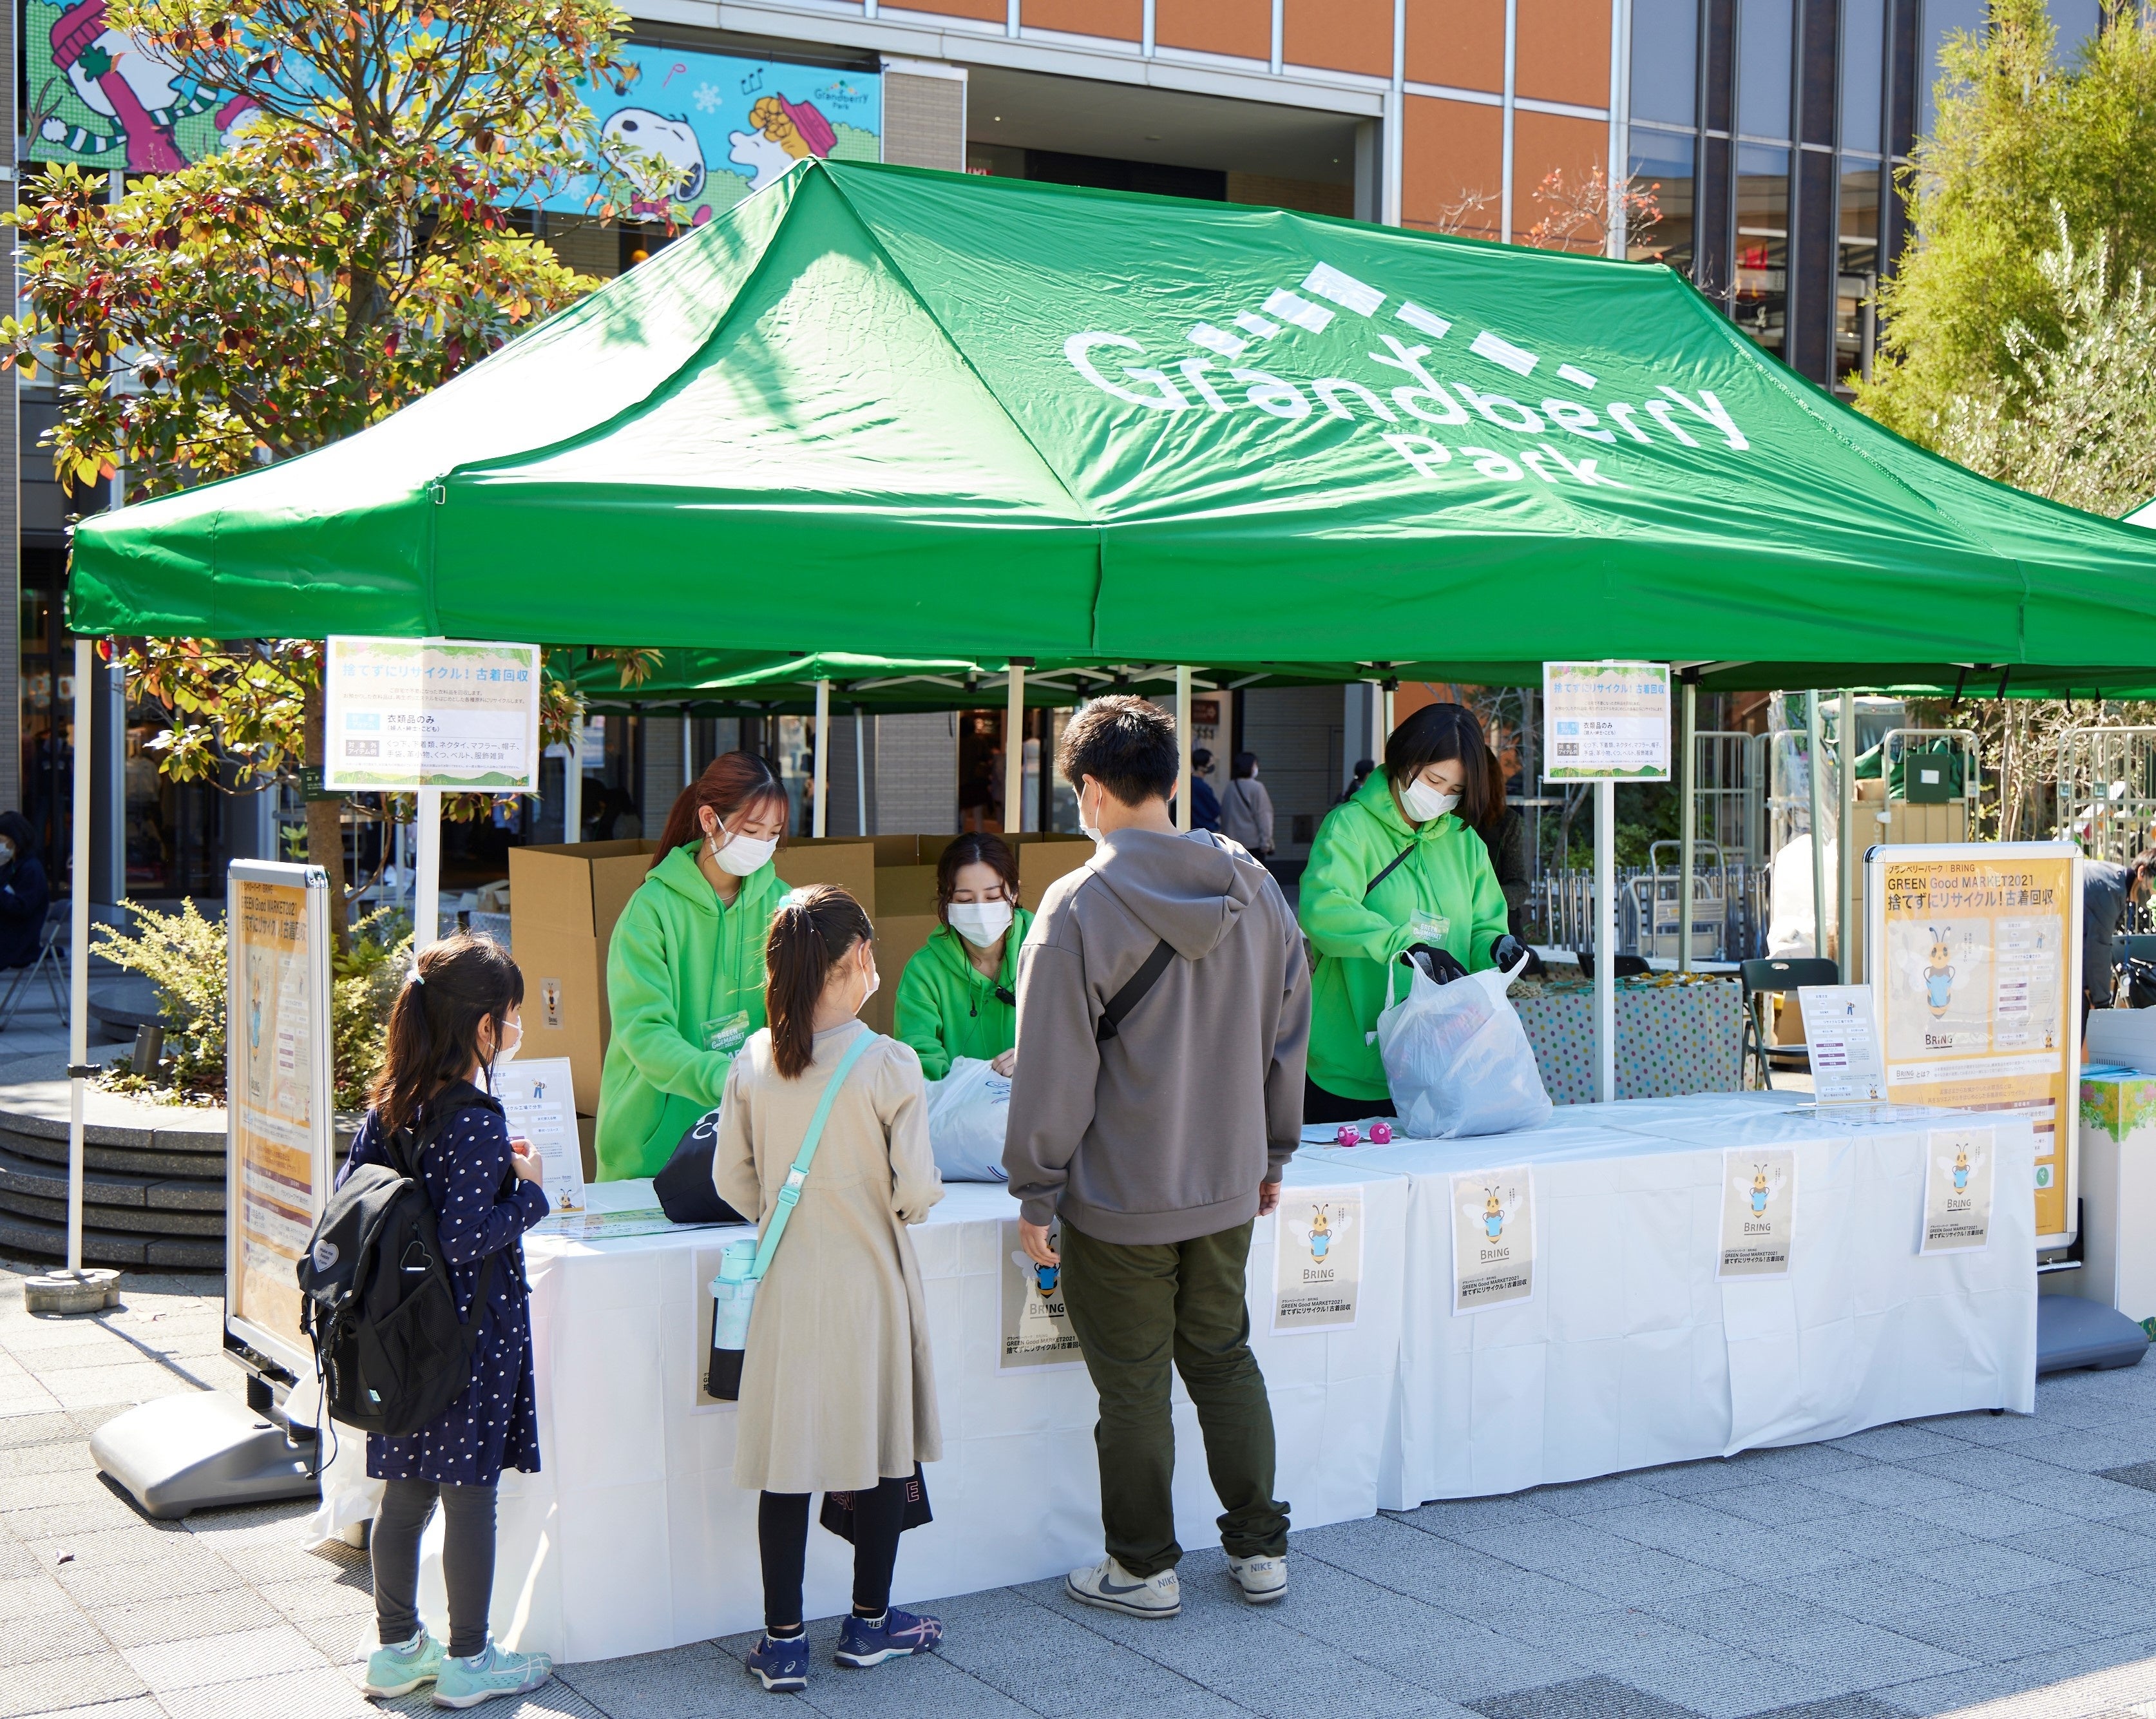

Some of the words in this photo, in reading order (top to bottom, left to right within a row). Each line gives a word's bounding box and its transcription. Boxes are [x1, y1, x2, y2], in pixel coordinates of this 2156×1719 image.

[1063, 331, 1750, 452] Grandberry
[1380, 432, 1630, 488] Park
[388, 715, 435, 724] 衣類品のみ
[1888, 865, 1943, 874] グランベリーパーク
[1951, 864, 1975, 872] BRING
[1888, 878, 1927, 890] GREEN
[1930, 877, 1958, 888] Good
[1961, 875, 2034, 888] MARKET2021
[717, 1028, 738, 1039] GREEN
[723, 1032, 745, 1044] MARKET
[1925, 1034, 1952, 1045] BRING
[1947, 1199, 1971, 1208] BRING
[1744, 1222, 1771, 1232] BRING
[1480, 1247, 1509, 1260] BRING
[1303, 1269, 1334, 1280] BRING
[1491, 1275, 1520, 1285] MARKET2021
[1030, 1303, 1065, 1315] BRING
[1040, 1336, 1075, 1344] MARKET2021
[1250, 1562, 1273, 1573] NIKE
[1158, 1576, 1176, 1588] NIKE
